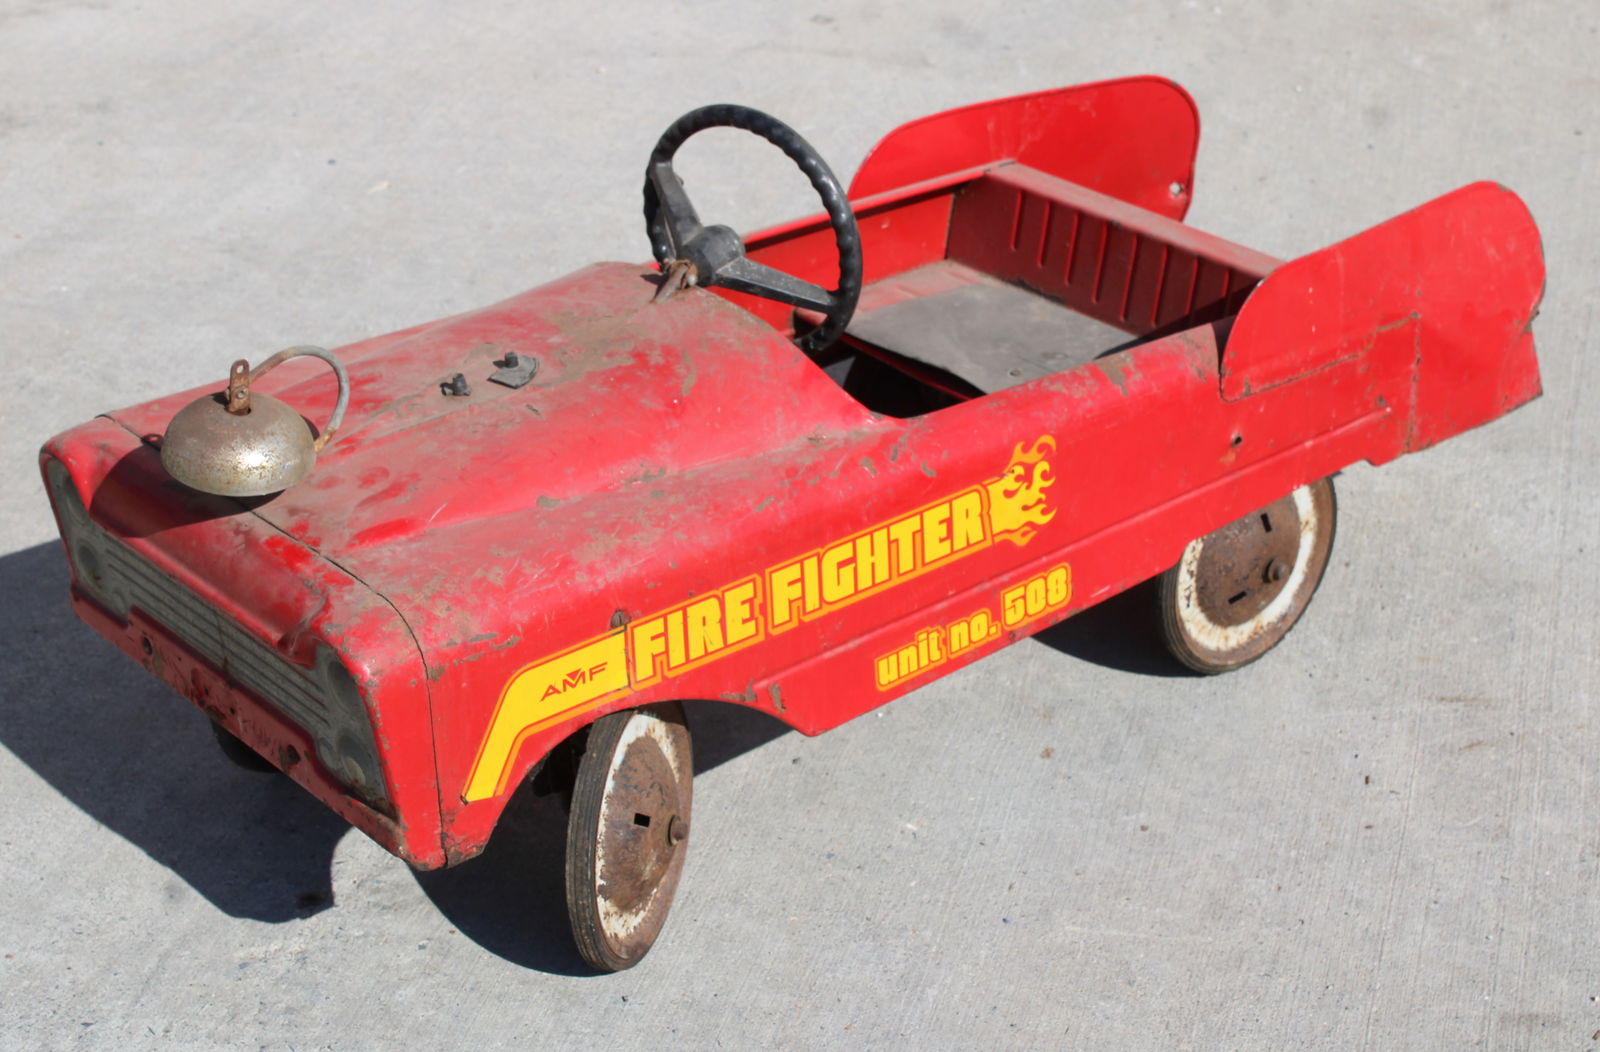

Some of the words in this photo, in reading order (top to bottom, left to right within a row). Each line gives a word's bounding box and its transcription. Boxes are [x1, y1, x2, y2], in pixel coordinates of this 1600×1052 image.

[632, 579, 757, 681] FIRE
[770, 490, 985, 625] FIGHTER
[878, 630, 942, 686] unit
[950, 613, 999, 650] no.
[1004, 567, 1069, 622] 508
[539, 661, 609, 702] AMF
